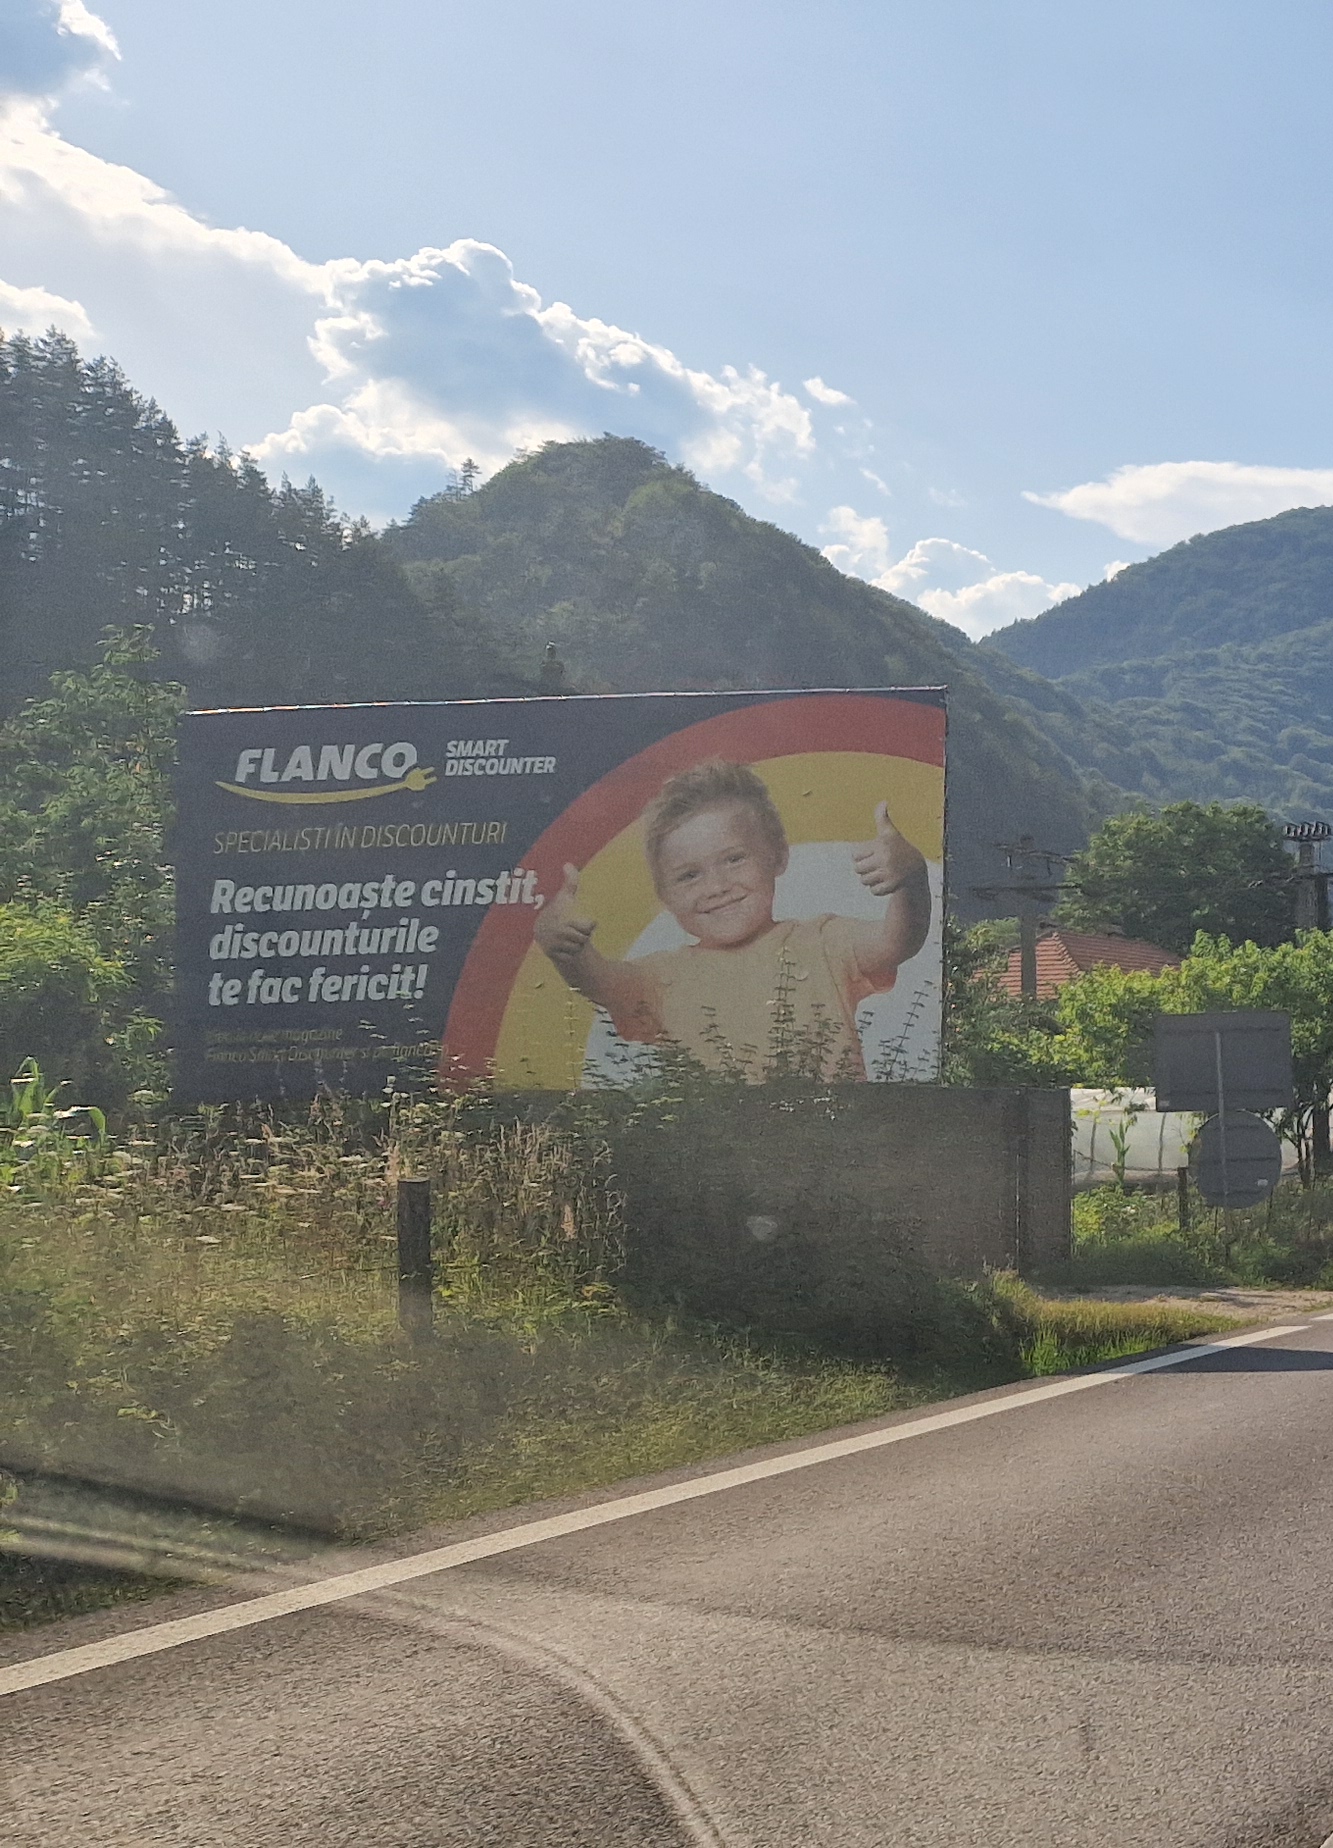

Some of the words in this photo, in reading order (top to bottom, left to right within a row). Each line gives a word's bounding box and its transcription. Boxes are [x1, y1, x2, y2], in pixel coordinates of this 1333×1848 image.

[234, 742, 418, 784] FLANCO
[445, 756, 557, 777] DISCOUNTER
[446, 739, 510, 758] SMART
[360, 821, 508, 849] DISCOUNTURI
[210, 873, 416, 920] Recunoaște
[421, 868, 545, 910] cinstit,
[209, 917, 440, 960] discounturile
[208, 972, 242, 1006] te
[246, 968, 302, 1005] fac
[308, 964, 429, 1003] fericit!
